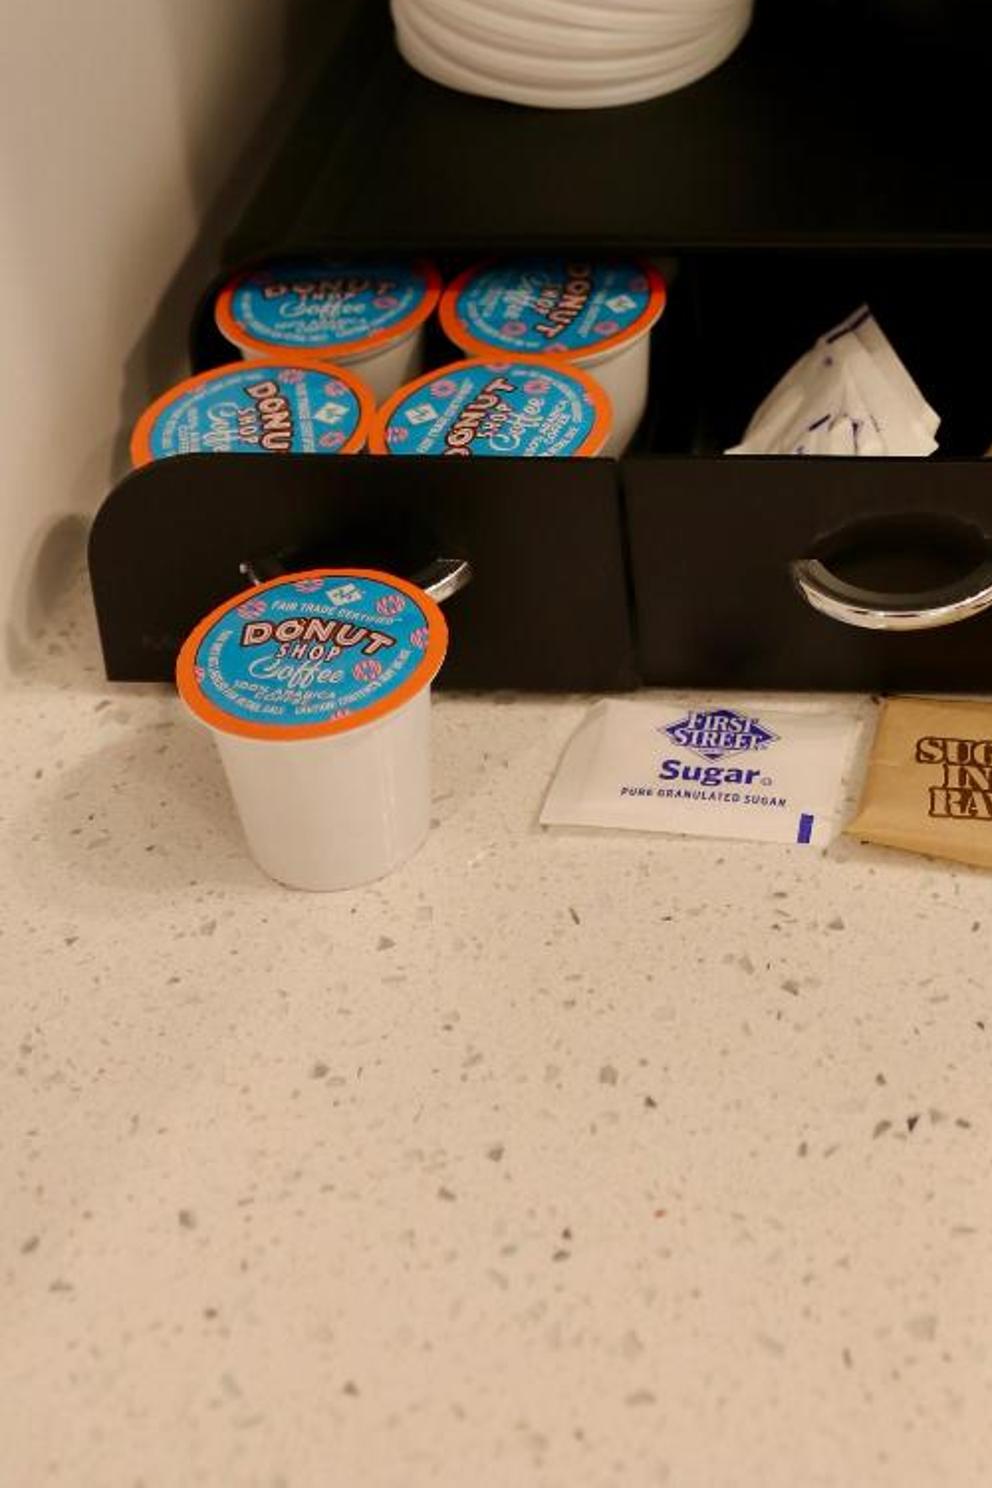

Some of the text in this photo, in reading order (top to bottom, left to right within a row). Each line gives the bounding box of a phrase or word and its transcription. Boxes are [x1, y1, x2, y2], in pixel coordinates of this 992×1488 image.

[244, 381, 292, 452] DONU
[271, 601, 297, 611] FAIR
[300, 603, 334, 616] TRADE
[240, 617, 396, 655] DONUT
[275, 643, 342, 662] SHOP
[248, 655, 345, 689] Coffee
[688, 711, 752, 734] FIRST
[674, 728, 762, 751] STREET
[658, 759, 760, 787] Sugar
[942, 764, 992, 792] IN
[620, 786, 787, 808] PURE GRANULATED SUGAR
